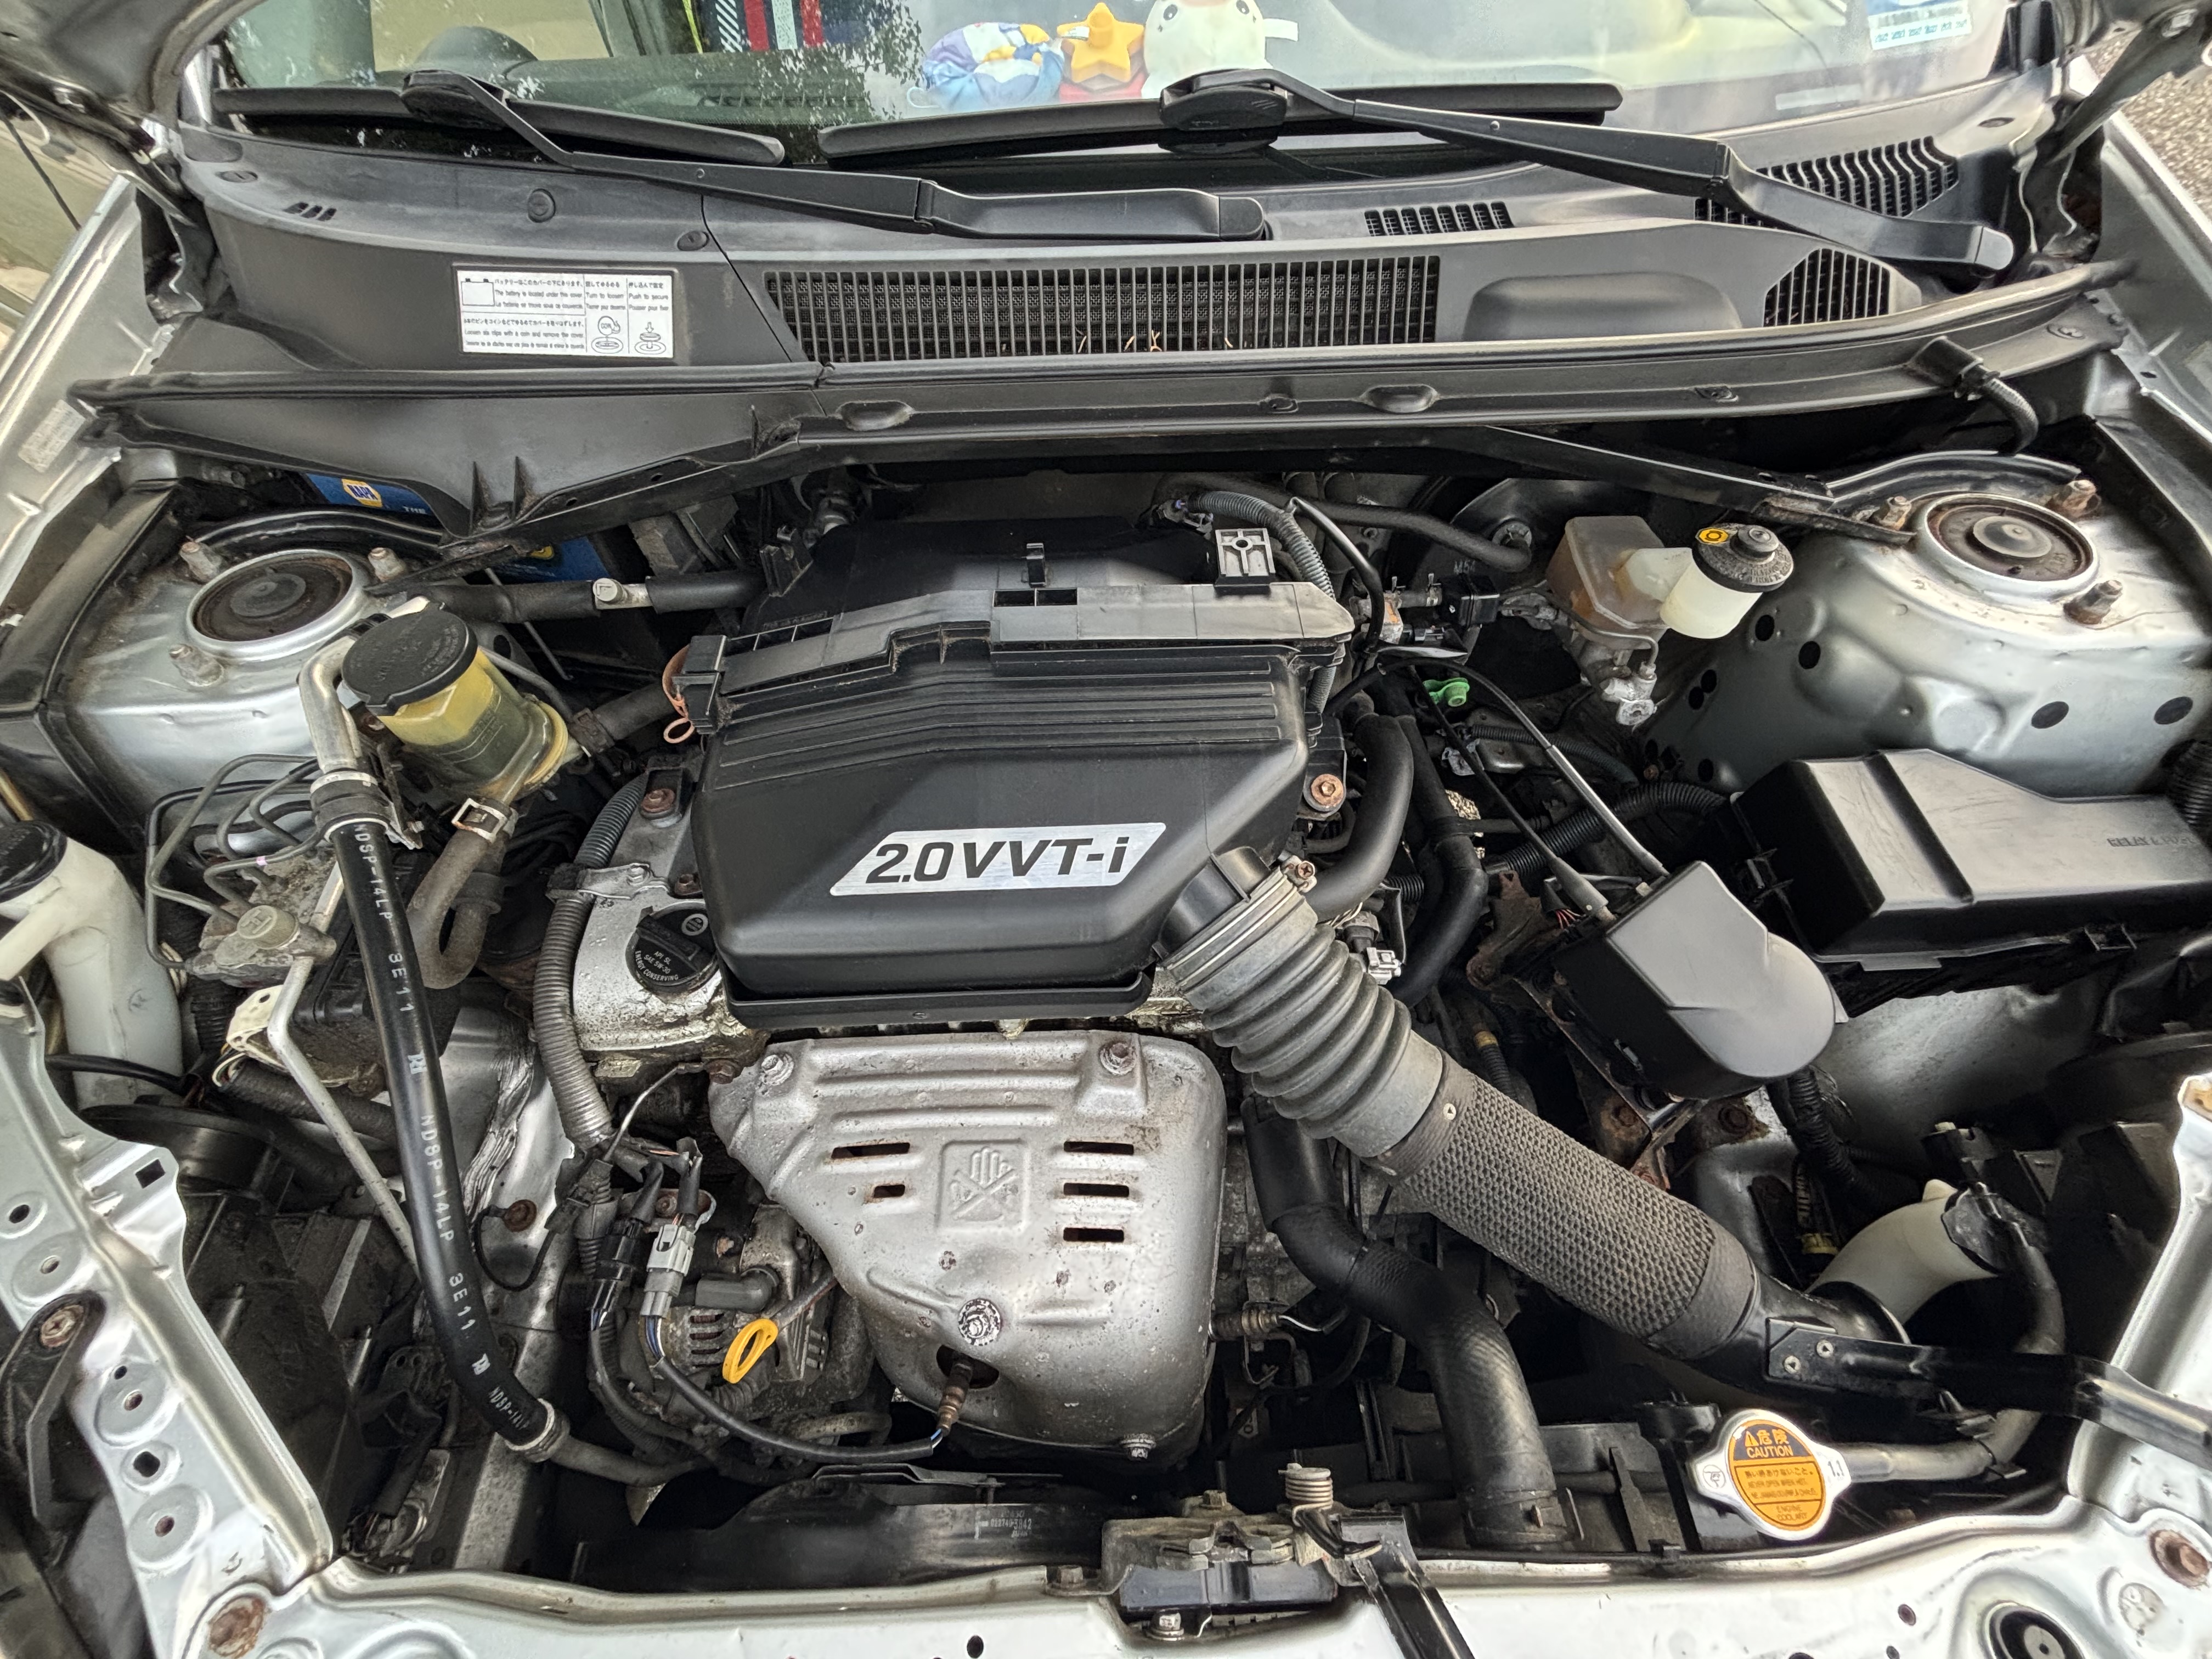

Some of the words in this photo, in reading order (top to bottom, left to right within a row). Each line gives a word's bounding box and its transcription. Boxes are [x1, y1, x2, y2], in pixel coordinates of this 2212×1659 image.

[347, 485, 379, 501] NAPA
[654, 951, 664, 960] API
[635, 950, 646, 970] ENERGY
[643, 969, 679, 981] CONSERVING
[644, 954, 655, 964] SAE
[653, 961, 671, 974] 5W-30
[1757, 1429, 1789, 1445] 危険
[1747, 1445, 1794, 1458] CAUTION
[1776, 1505, 1802, 1513] ENGINE
